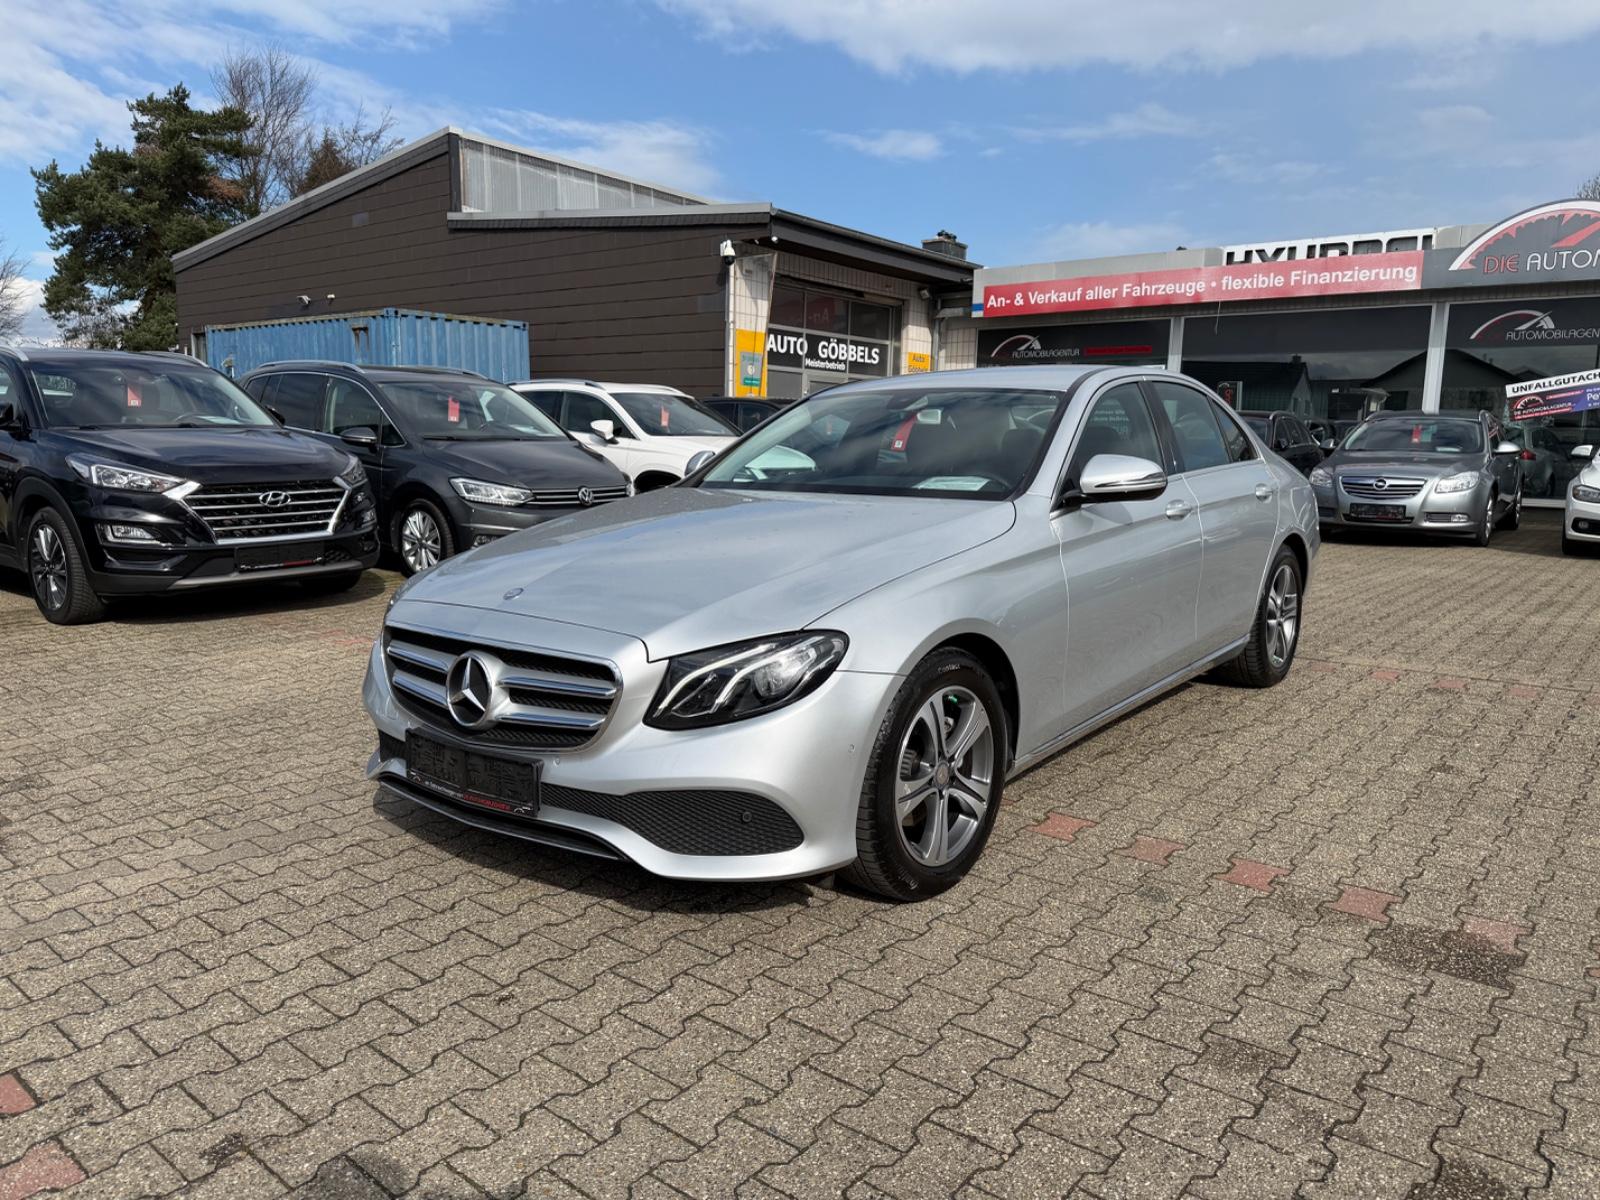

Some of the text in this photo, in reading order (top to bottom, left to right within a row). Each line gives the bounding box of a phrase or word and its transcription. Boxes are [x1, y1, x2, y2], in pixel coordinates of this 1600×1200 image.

[1484, 255, 1519, 273] DIE
[987, 265, 1417, 308] An- & Verkauf aller Fahrzeuge flexible Finanzierung
[767, 334, 880, 364] AUTO GÖBBELS
[1012, 348, 1080, 359] AUTOMOBILAGENTUR
[805, 357, 846, 371] Meisterbetrieb
